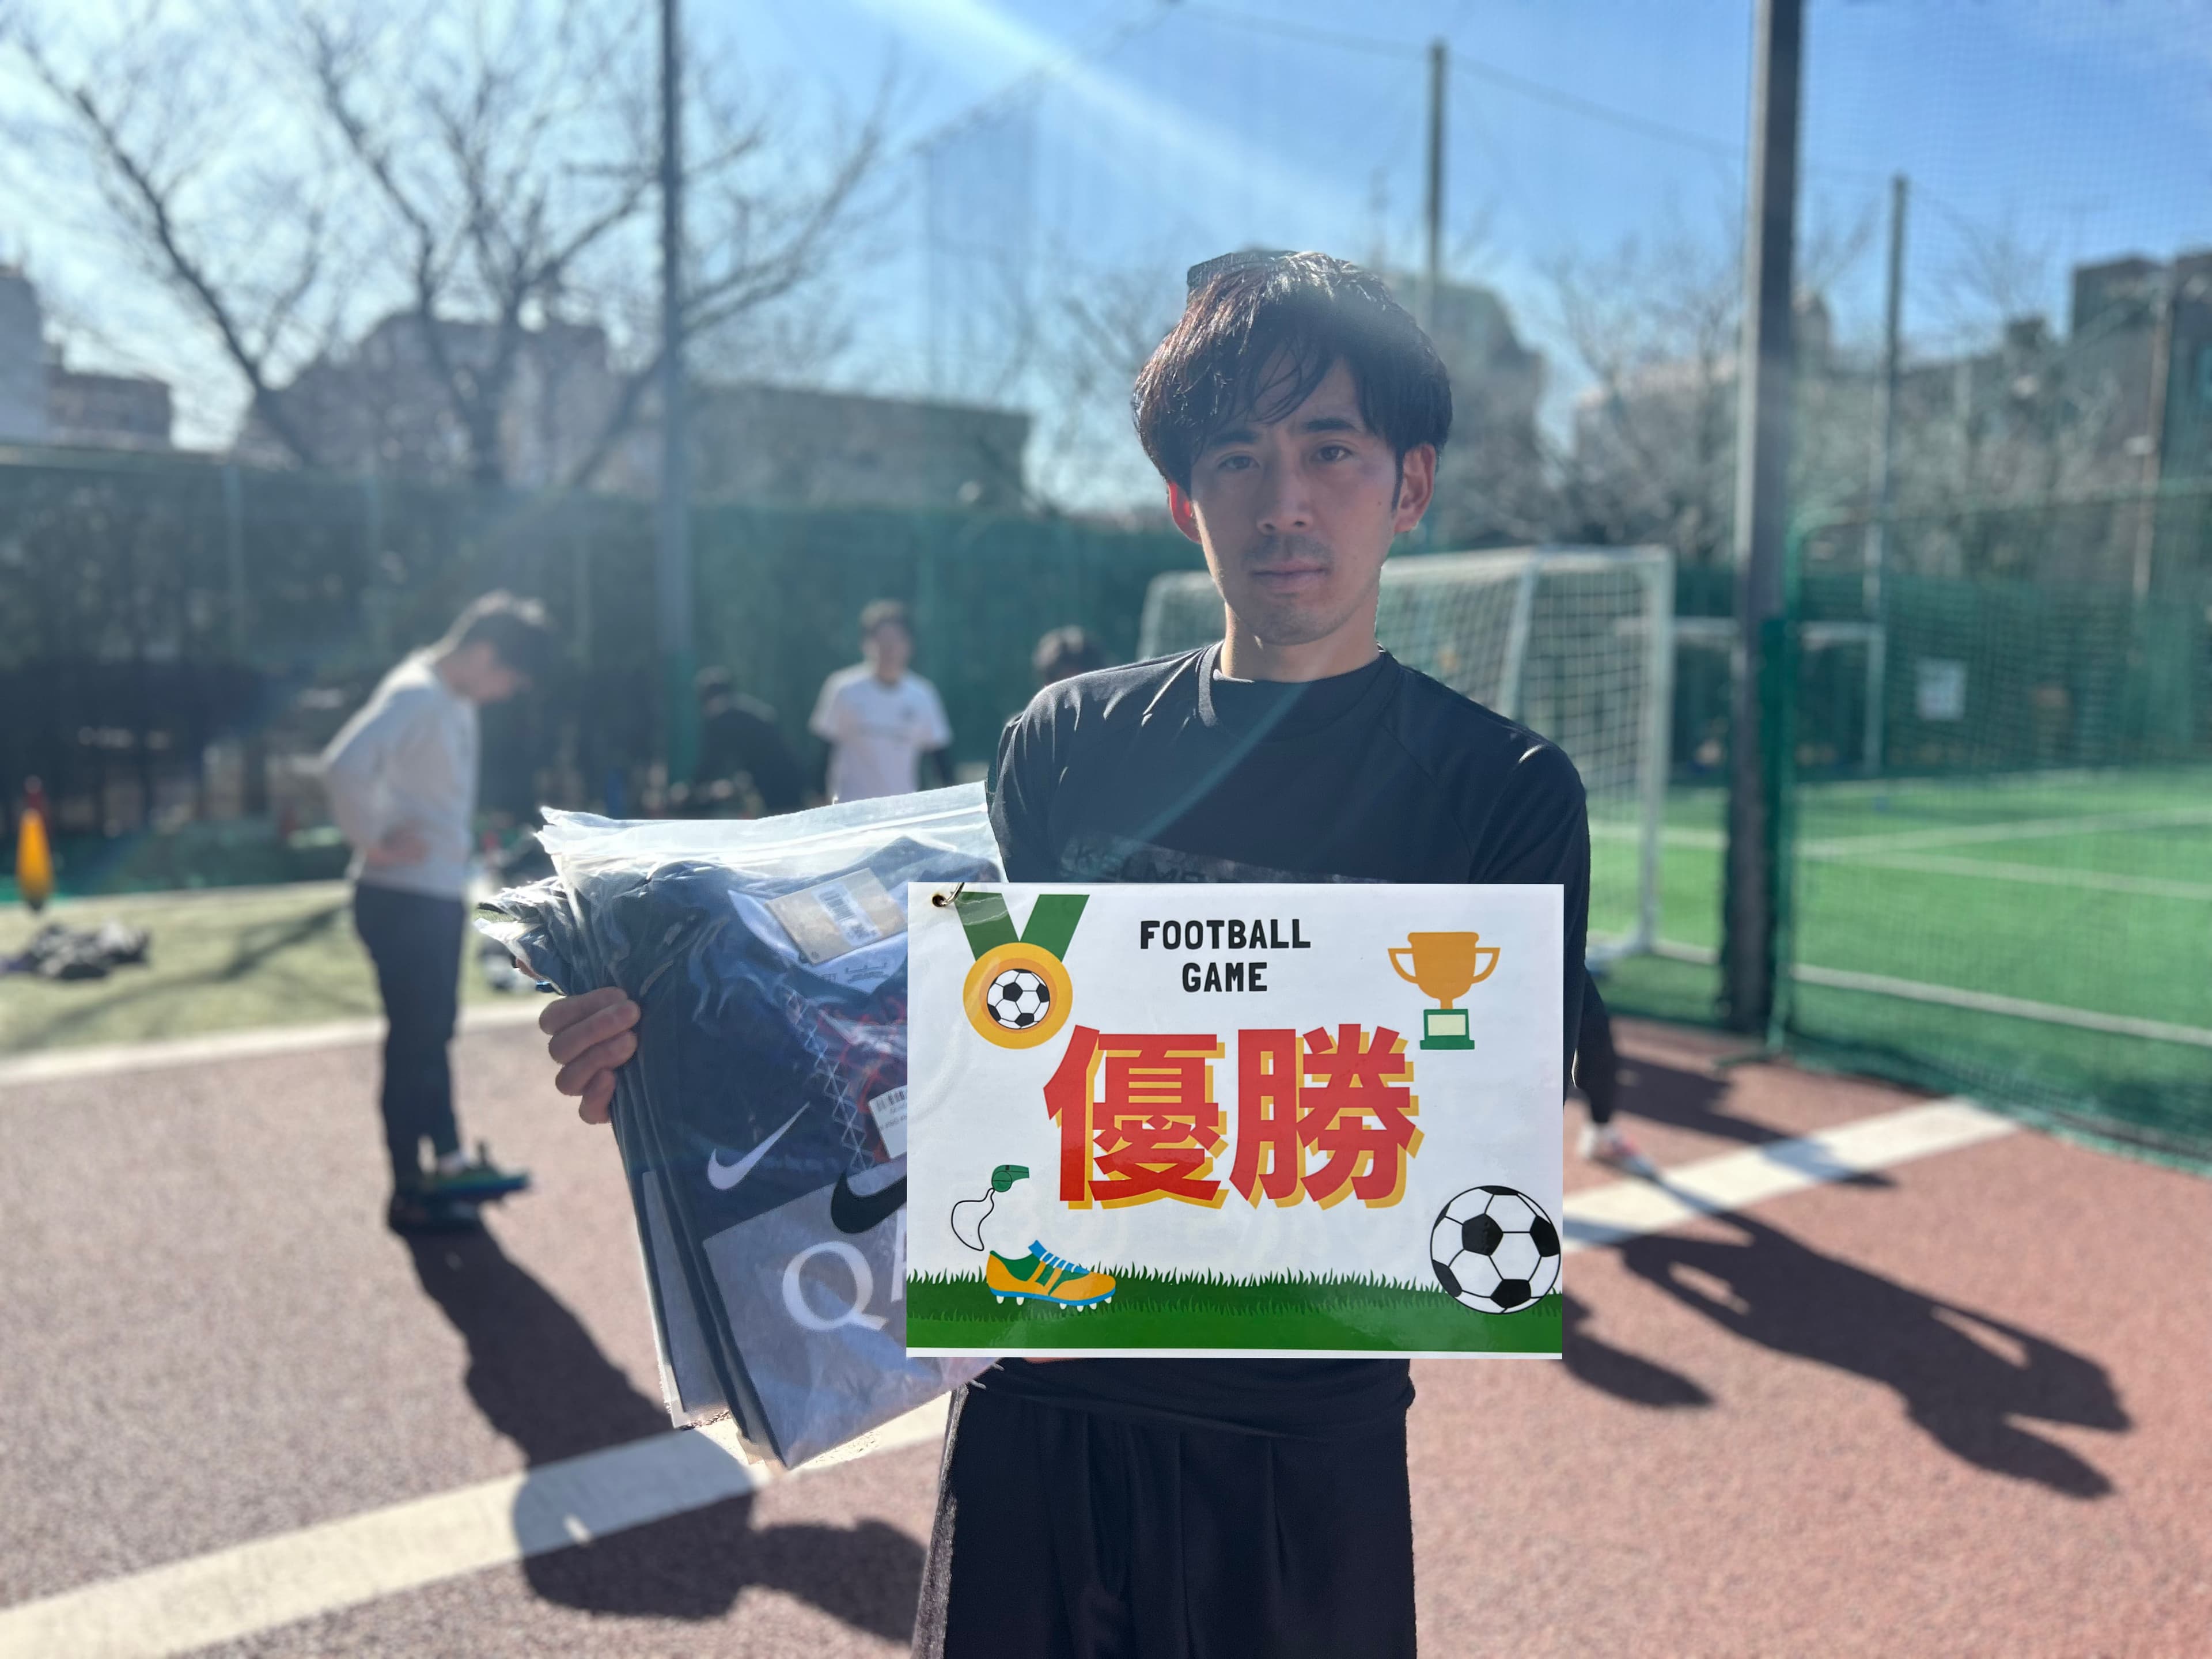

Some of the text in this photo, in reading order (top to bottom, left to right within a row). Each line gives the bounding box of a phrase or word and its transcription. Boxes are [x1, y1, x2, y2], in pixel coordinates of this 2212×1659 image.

[1140, 919, 1312, 950] FOOTBALL
[1181, 961, 1268, 993] GAME
[1043, 1024, 1424, 1209] 優勝
